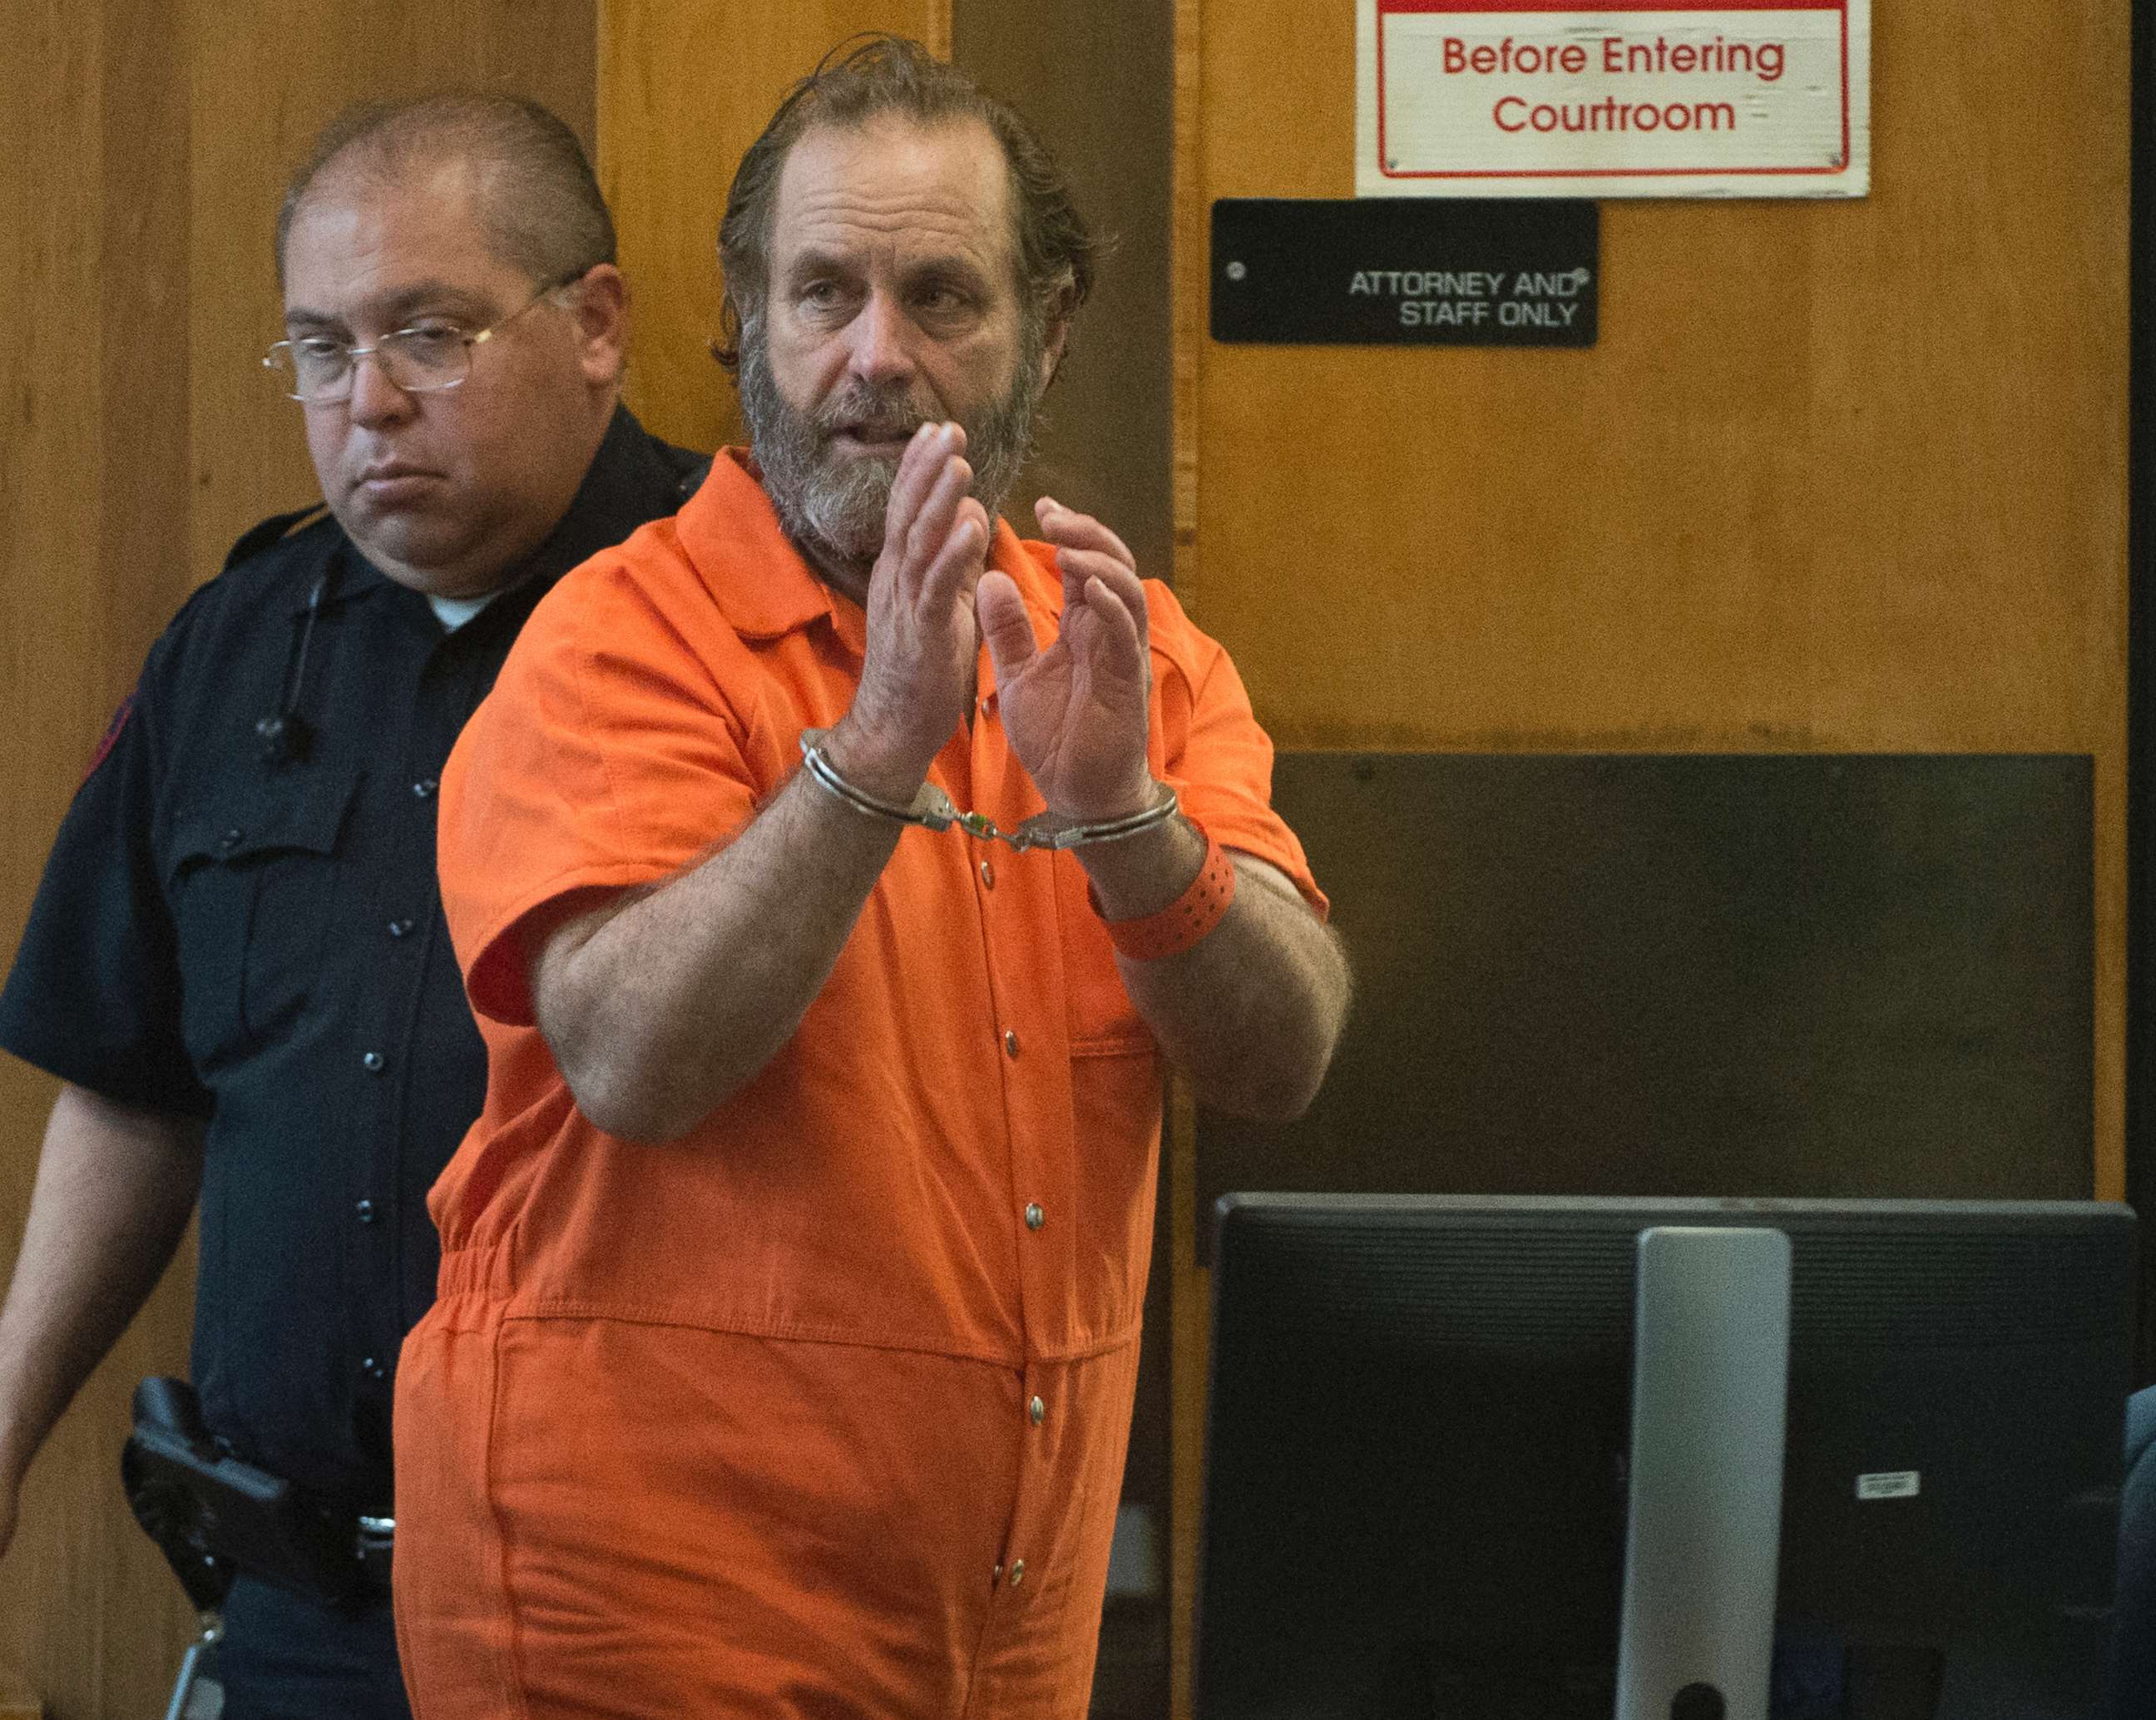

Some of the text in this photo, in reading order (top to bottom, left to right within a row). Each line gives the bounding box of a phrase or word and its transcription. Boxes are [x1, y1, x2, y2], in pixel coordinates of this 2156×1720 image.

[1442, 36, 1786, 82] Before Entering
[1492, 96, 1736, 133] Courtroom
[1350, 271, 1579, 296] ATTORNEY AND
[1399, 301, 1579, 327] STAFF ONLY
